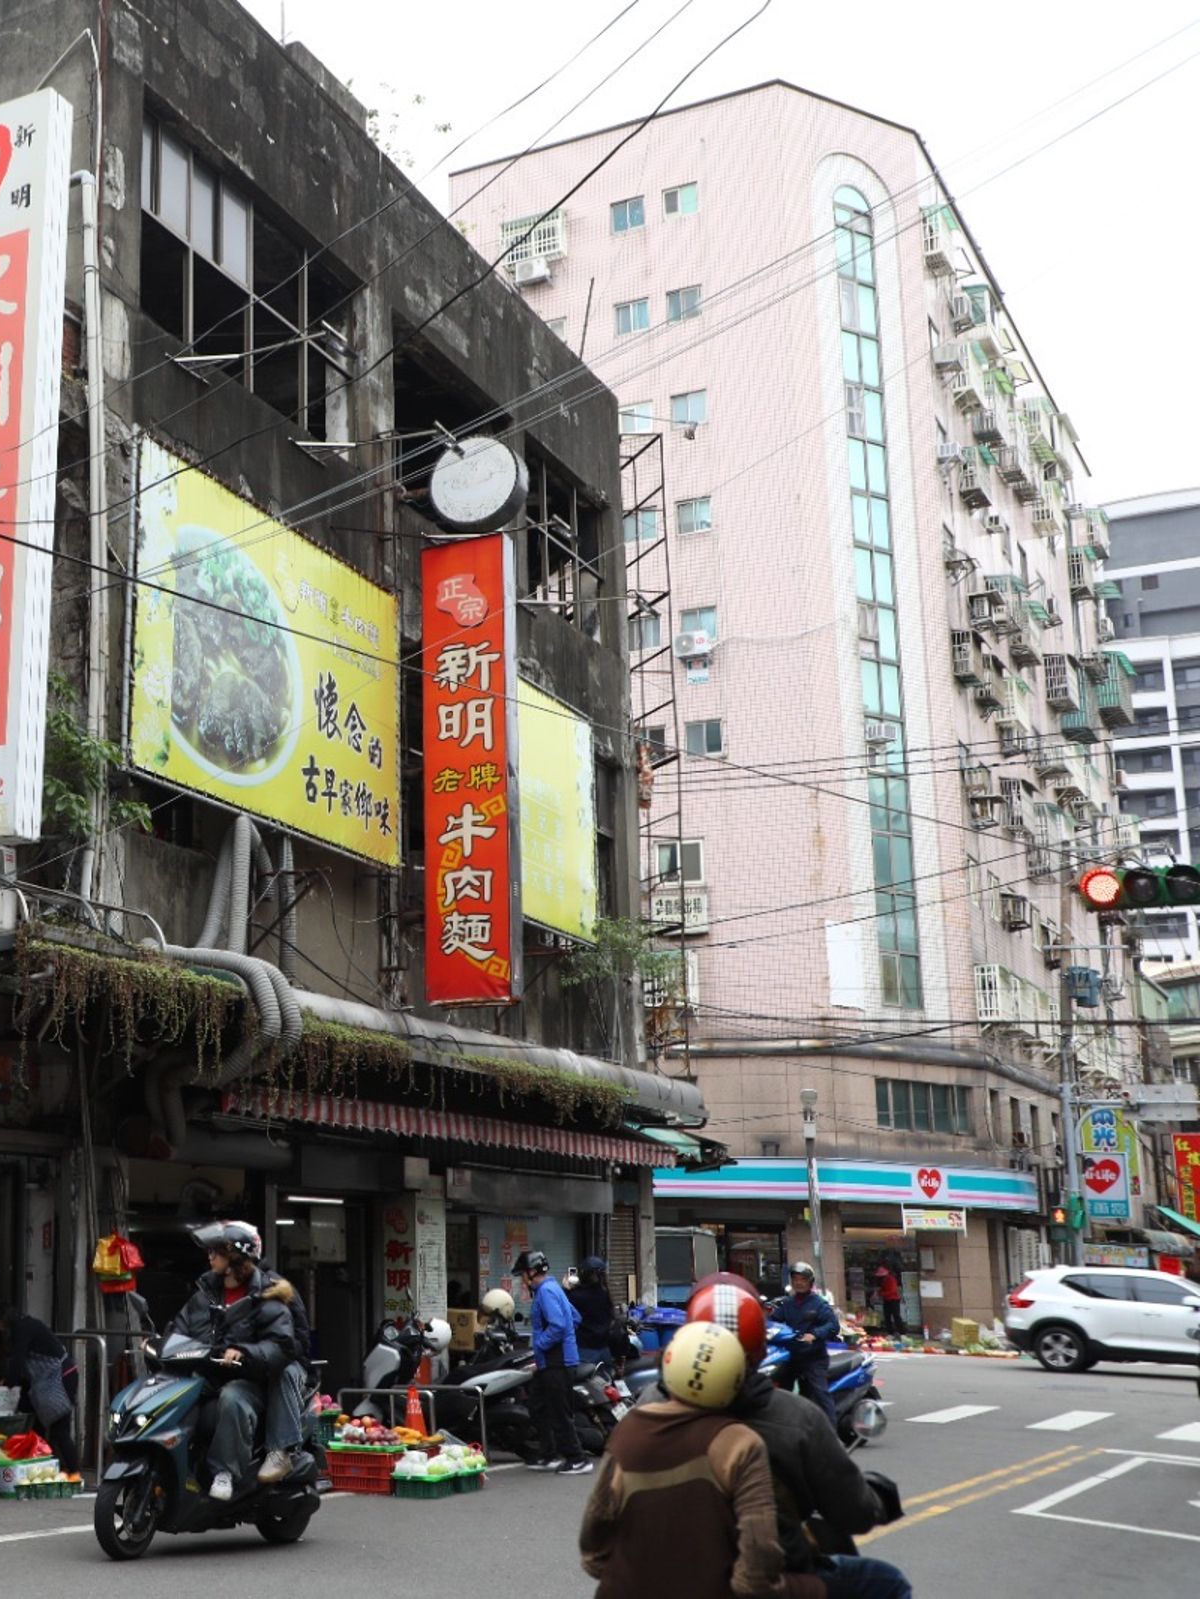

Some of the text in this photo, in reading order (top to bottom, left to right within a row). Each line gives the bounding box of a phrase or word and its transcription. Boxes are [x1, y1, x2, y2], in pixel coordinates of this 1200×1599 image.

[438, 577, 485, 621] 正宗
[314, 671, 383, 771] 懷念的
